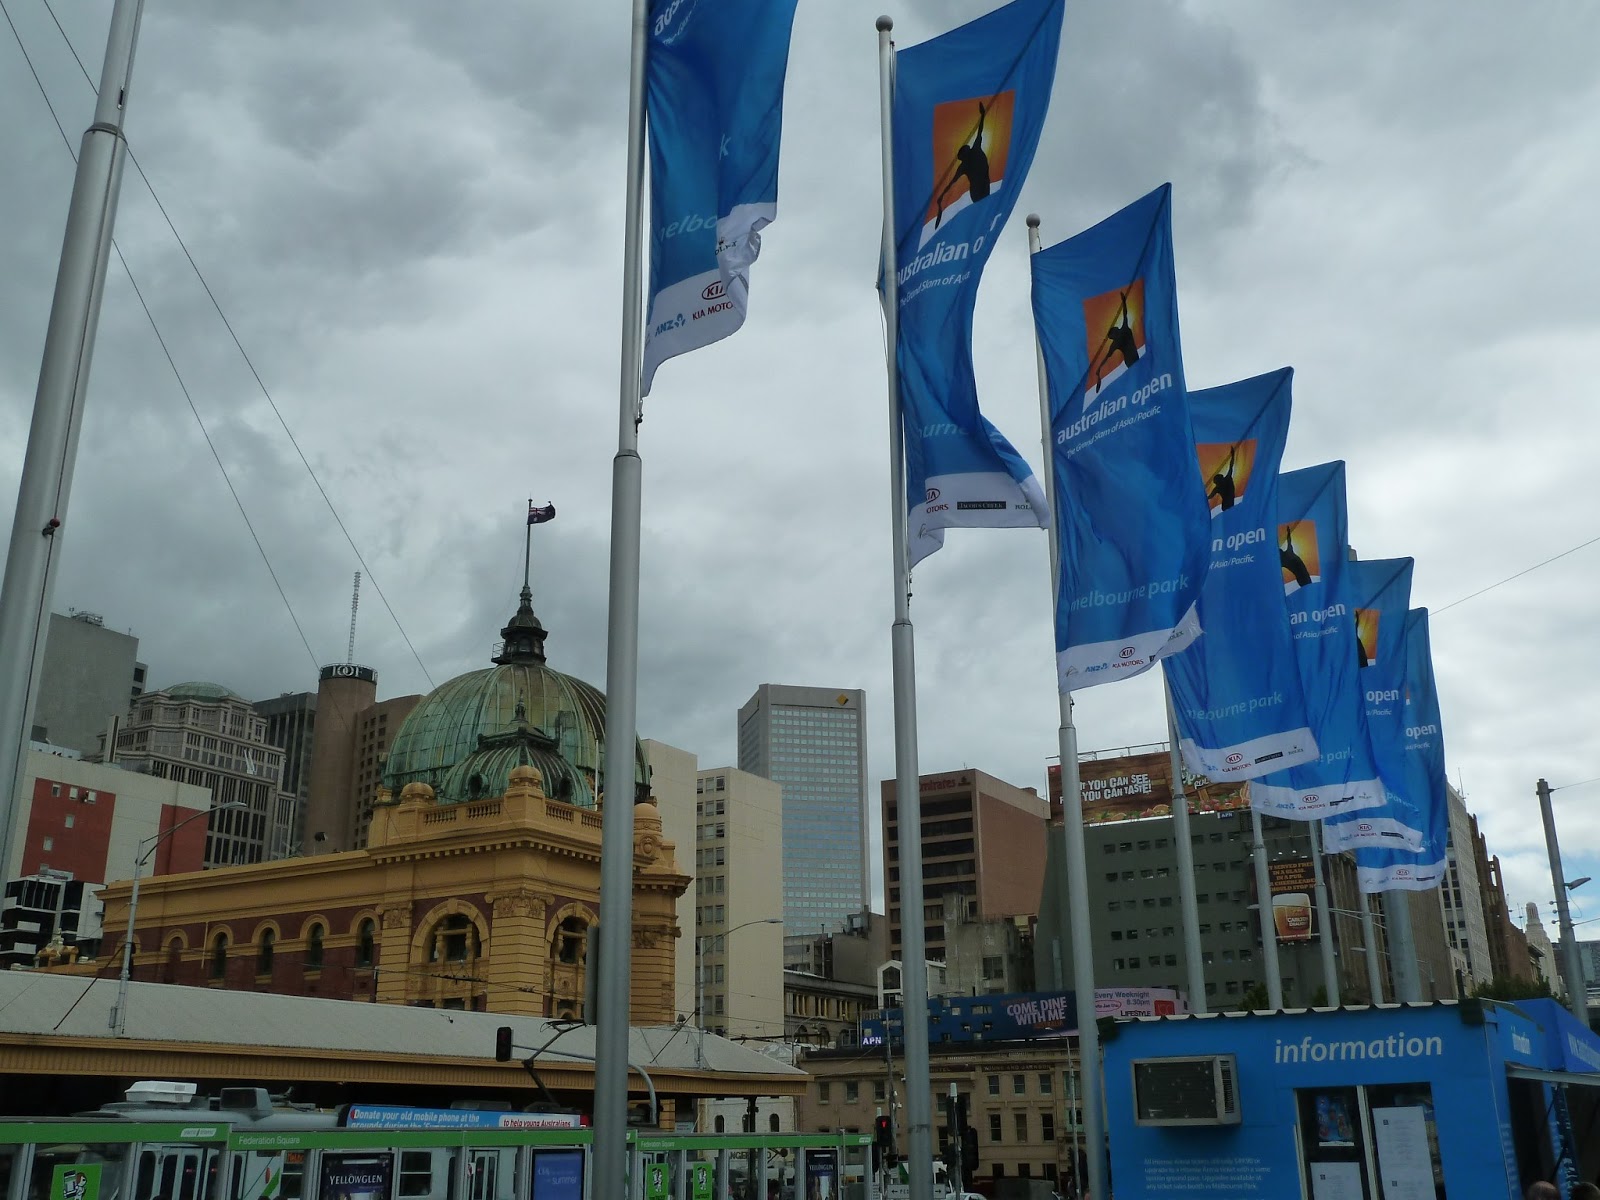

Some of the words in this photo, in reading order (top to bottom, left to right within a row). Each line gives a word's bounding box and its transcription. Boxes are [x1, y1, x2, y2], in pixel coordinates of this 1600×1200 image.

[692, 309, 705, 321] KIA
[707, 301, 734, 316] MOTO
[655, 321, 675, 337] ANZ
[1057, 395, 1127, 445] australian
[1131, 373, 1172, 406] open
[1094, 428, 1111, 442] Slam
[926, 503, 949, 514] OTORS
[1226, 527, 1266, 551] open
[1070, 585, 1145, 612] melbourne
[1148, 574, 1189, 599] park
[1312, 603, 1346, 624] open
[1121, 659, 1144, 668] MOTORS
[1249, 691, 1283, 713] park
[1366, 689, 1399, 705] open
[1405, 724, 1437, 739] open
[1088, 780, 1106, 790] YOU
[1109, 777, 1128, 788] CAN
[1082, 791, 1101, 801] YOU
[1103, 788, 1123, 799] CAN
[1124, 784, 1152, 795] TASTE!
[1116, 991, 1150, 999] Weeknight
[1007, 1001, 1038, 1016] COME
[1040, 996, 1068, 1011] DINE
[1015, 1011, 1046, 1026] WITH
[1047, 1008, 1066, 1021] ME
[863, 1036, 881, 1045] APN
[1275, 1032, 1442, 1064] information
[354, 1109, 380, 1120] Donate
[382, 1111, 399, 1121] your
[400, 1111, 412, 1120] old
[414, 1111, 438, 1121] mobile
[438, 1113, 459, 1123] phone
[460, 1114, 468, 1122] at
[468, 1113, 479, 1122] the
[503, 1119, 509, 1127] to
[239, 1136, 276, 1145] Federation
[276, 1136, 300, 1145] Square
[330, 1174, 383, 1185] YELLOWGLEN
